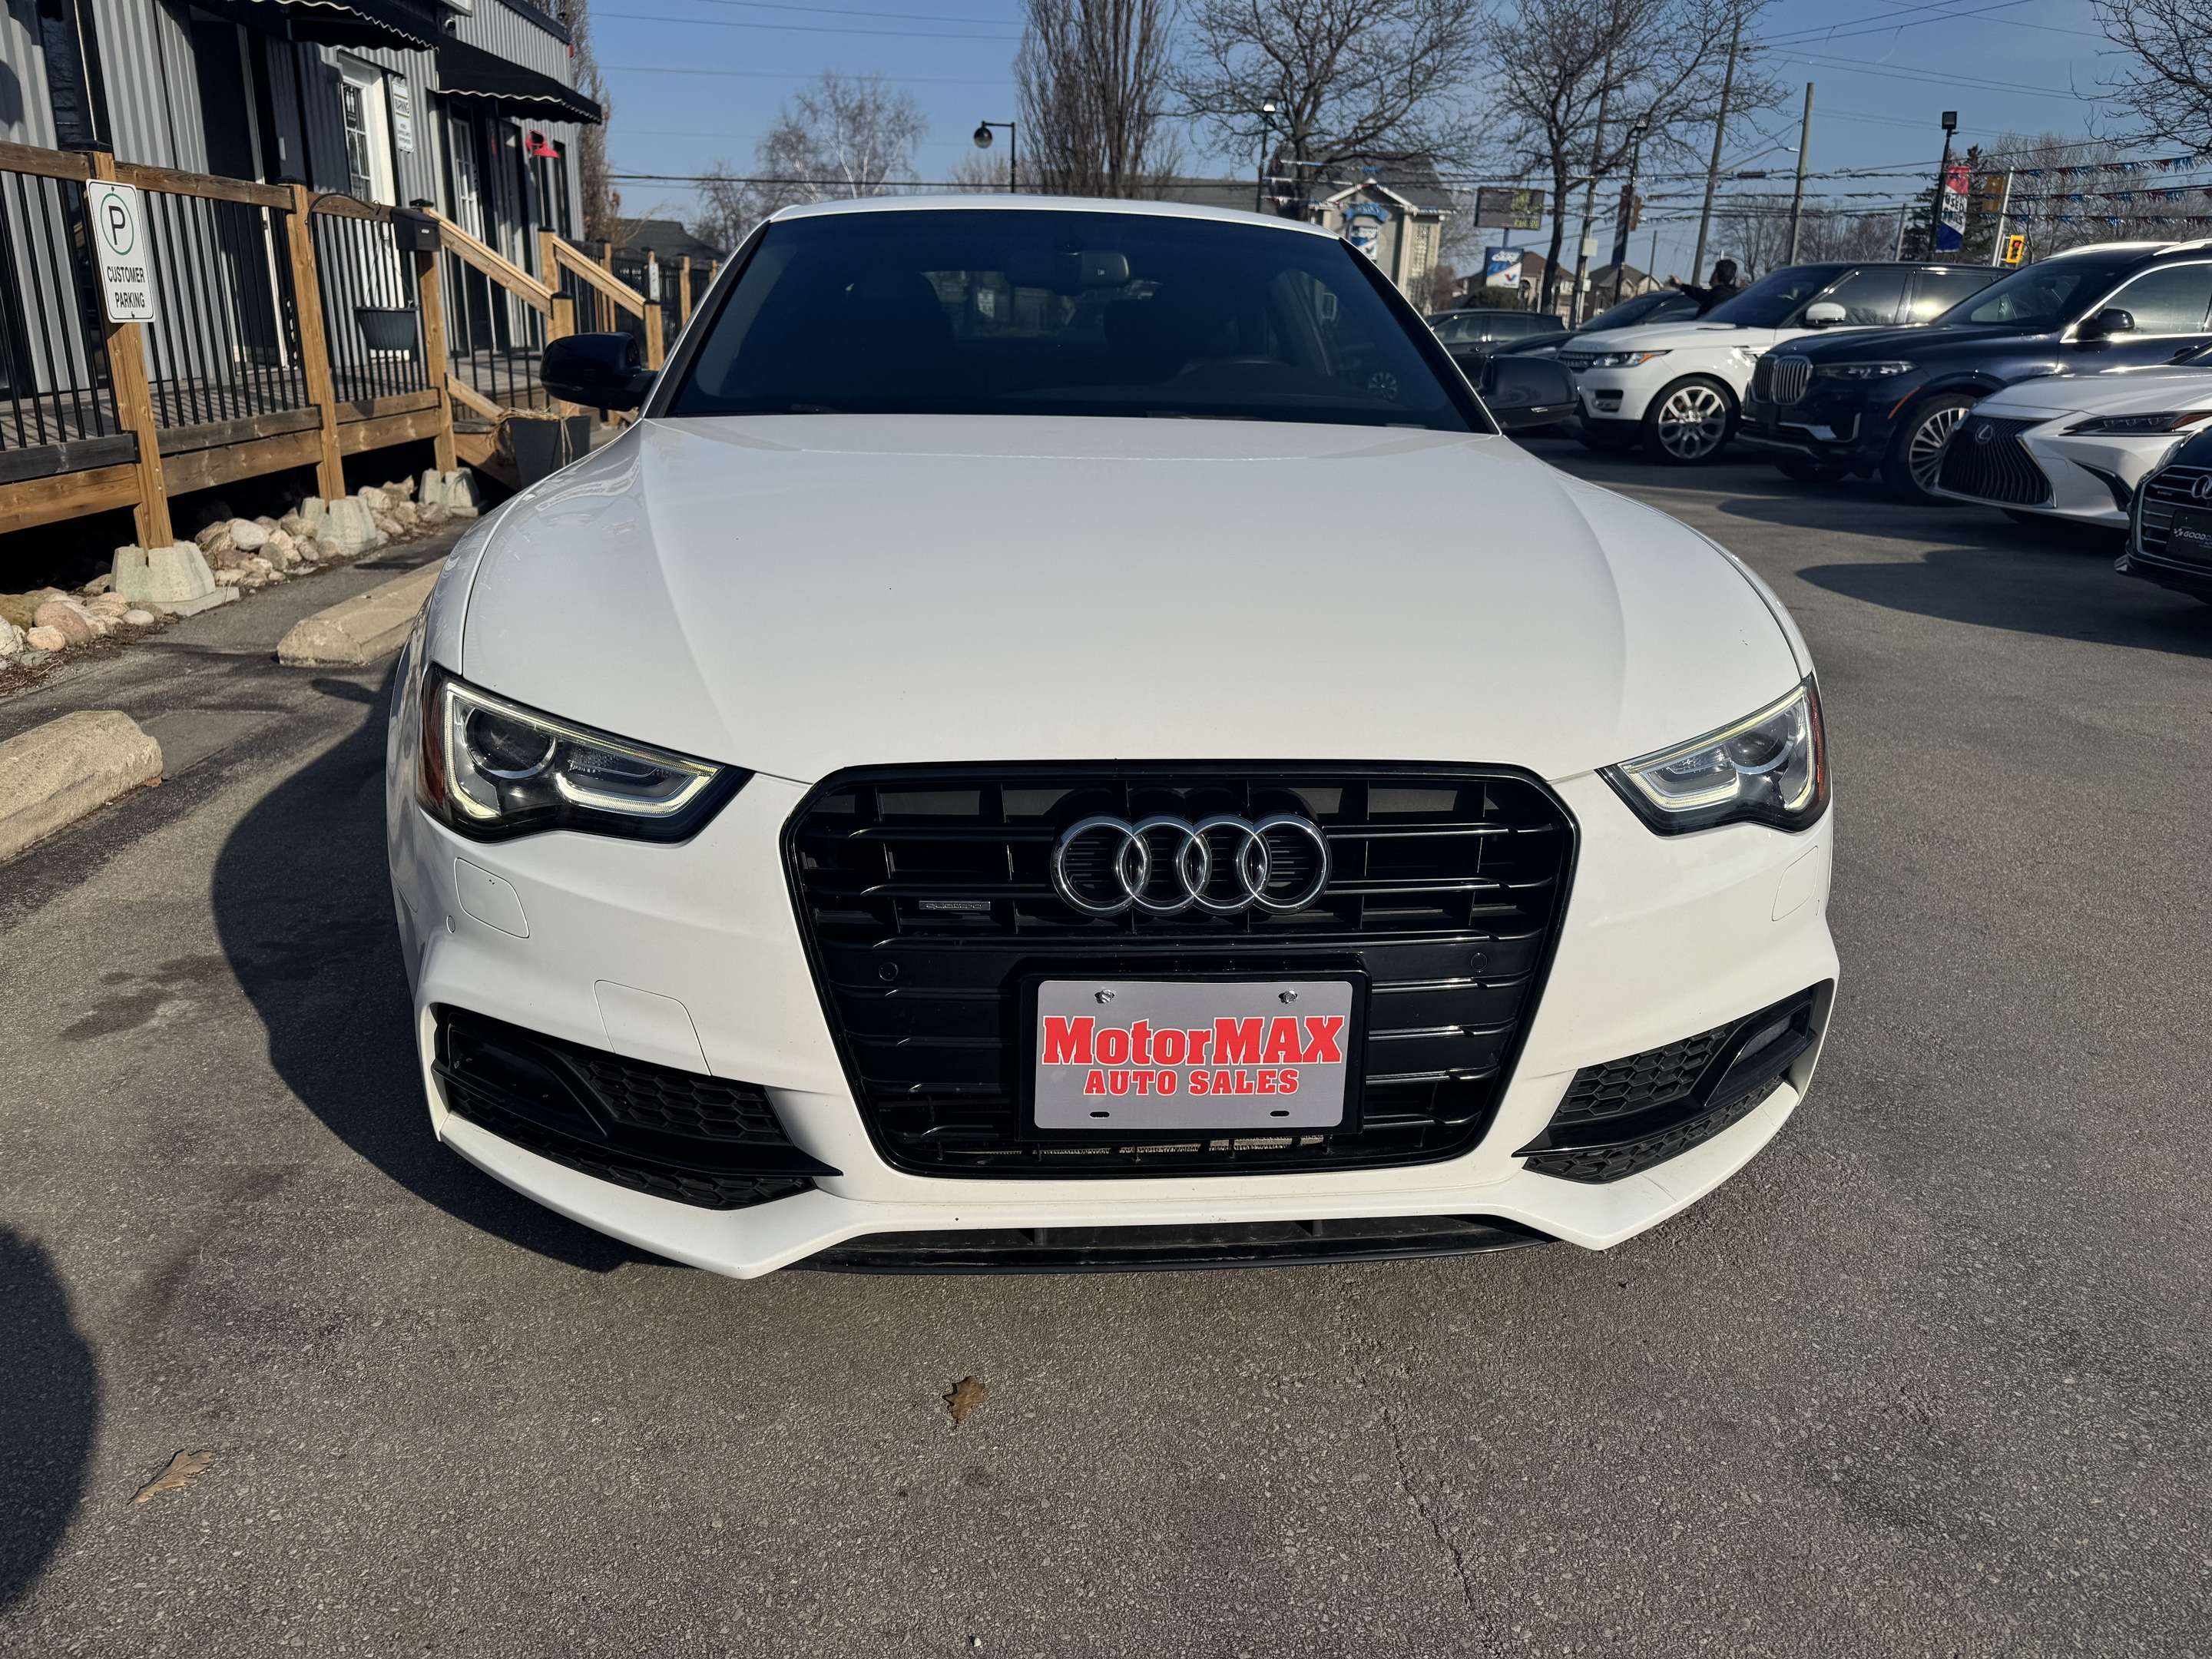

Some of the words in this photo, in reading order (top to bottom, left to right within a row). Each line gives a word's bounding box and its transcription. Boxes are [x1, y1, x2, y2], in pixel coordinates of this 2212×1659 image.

[108, 205, 126, 246] P
[107, 266, 145, 283] CUSTOMER
[114, 292, 145, 308] PARKING
[1041, 1015, 1345, 1066] MotorMAX
[1083, 1068, 1178, 1096] AUTO
[1188, 1068, 1300, 1096] SALES
